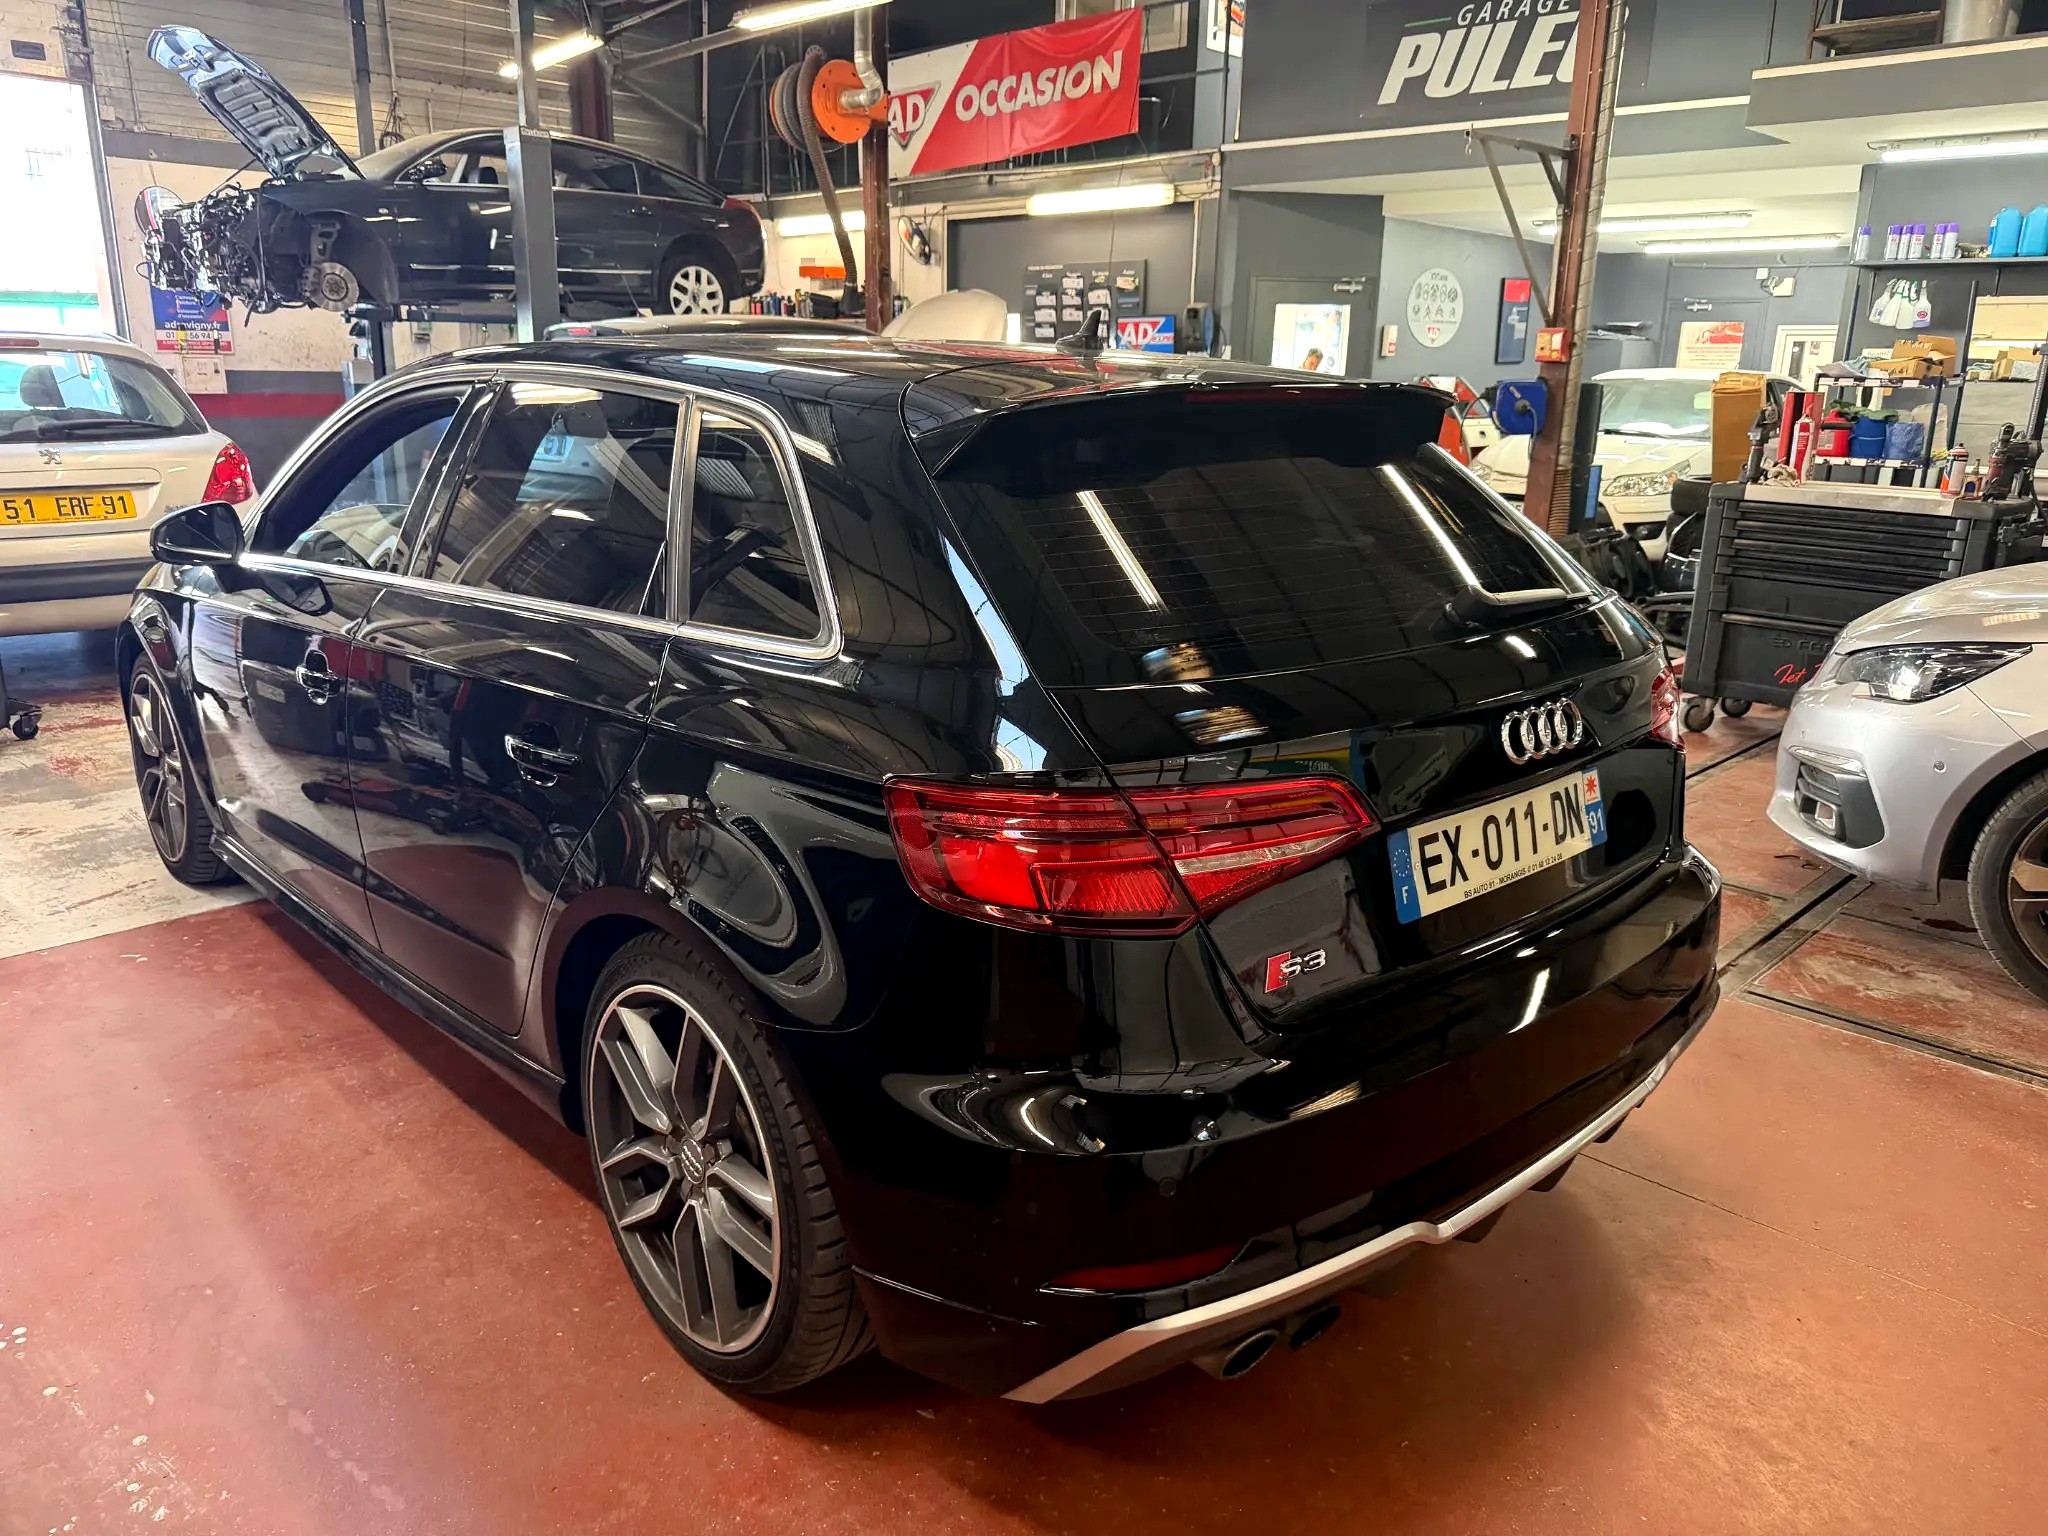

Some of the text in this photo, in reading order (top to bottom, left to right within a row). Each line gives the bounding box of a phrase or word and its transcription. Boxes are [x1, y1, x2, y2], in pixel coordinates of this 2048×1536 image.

[1457, 0, 1571, 26] GARAGE
[888, 50, 1123, 134] AD OCCASION
[164, 320, 222, 331] advigny.fr
[1122, 322, 1153, 346] AD
[101, 495, 128, 515] 91
[1401, 783, 1604, 905] F EX-011-DN 91
[1473, 883, 1488, 896] AUTO
[1498, 868, 1526, 884] MORANGIS
[1279, 948, 1326, 982] S3
